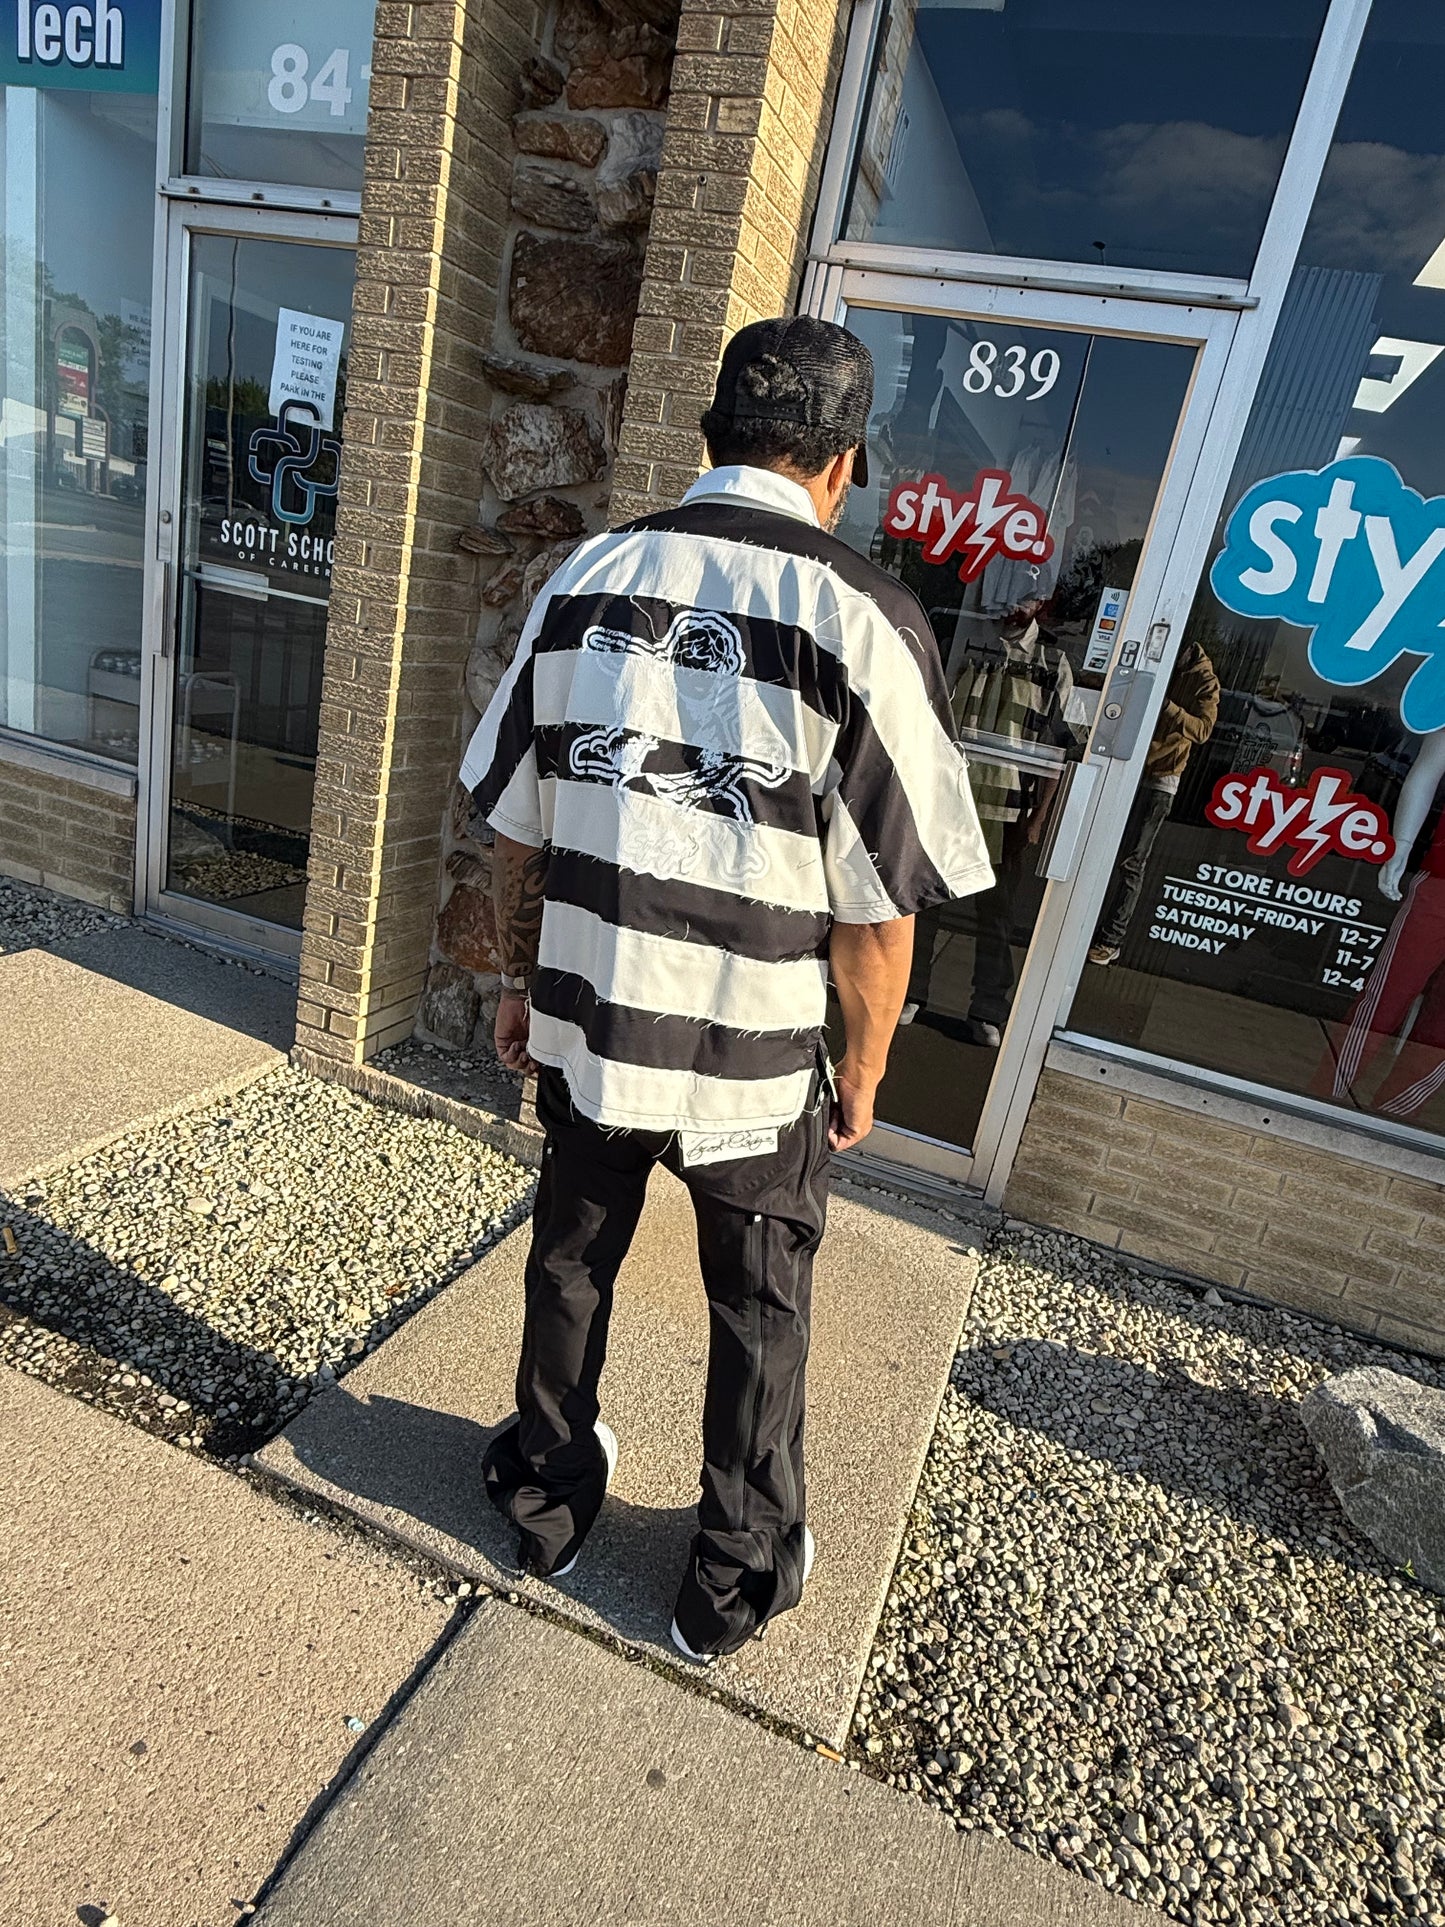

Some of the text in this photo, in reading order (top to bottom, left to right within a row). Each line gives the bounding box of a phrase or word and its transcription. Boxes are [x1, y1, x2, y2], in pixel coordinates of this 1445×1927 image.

[268, 43, 373, 117] 84
[290, 323, 331, 341] IF YOU ARE
[290, 339, 328, 356] HERE FOR
[290, 370, 319, 385] PLEASE
[291, 354, 323, 370] TESTING
[963, 341, 1061, 401] 839
[280, 382, 326, 402] PARK IN THE
[220, 519, 279, 553] SCOTT
[238, 550, 331, 577] OF CAREER
[1196, 863, 1363, 917] STORE HOURS
[1162, 884, 1383, 950] TUESDAY-FRIDAY 12-7
[1155, 904, 1375, 971] SATURDAY 11-7
[1149, 924, 1366, 992] SUNDAY 12-4
